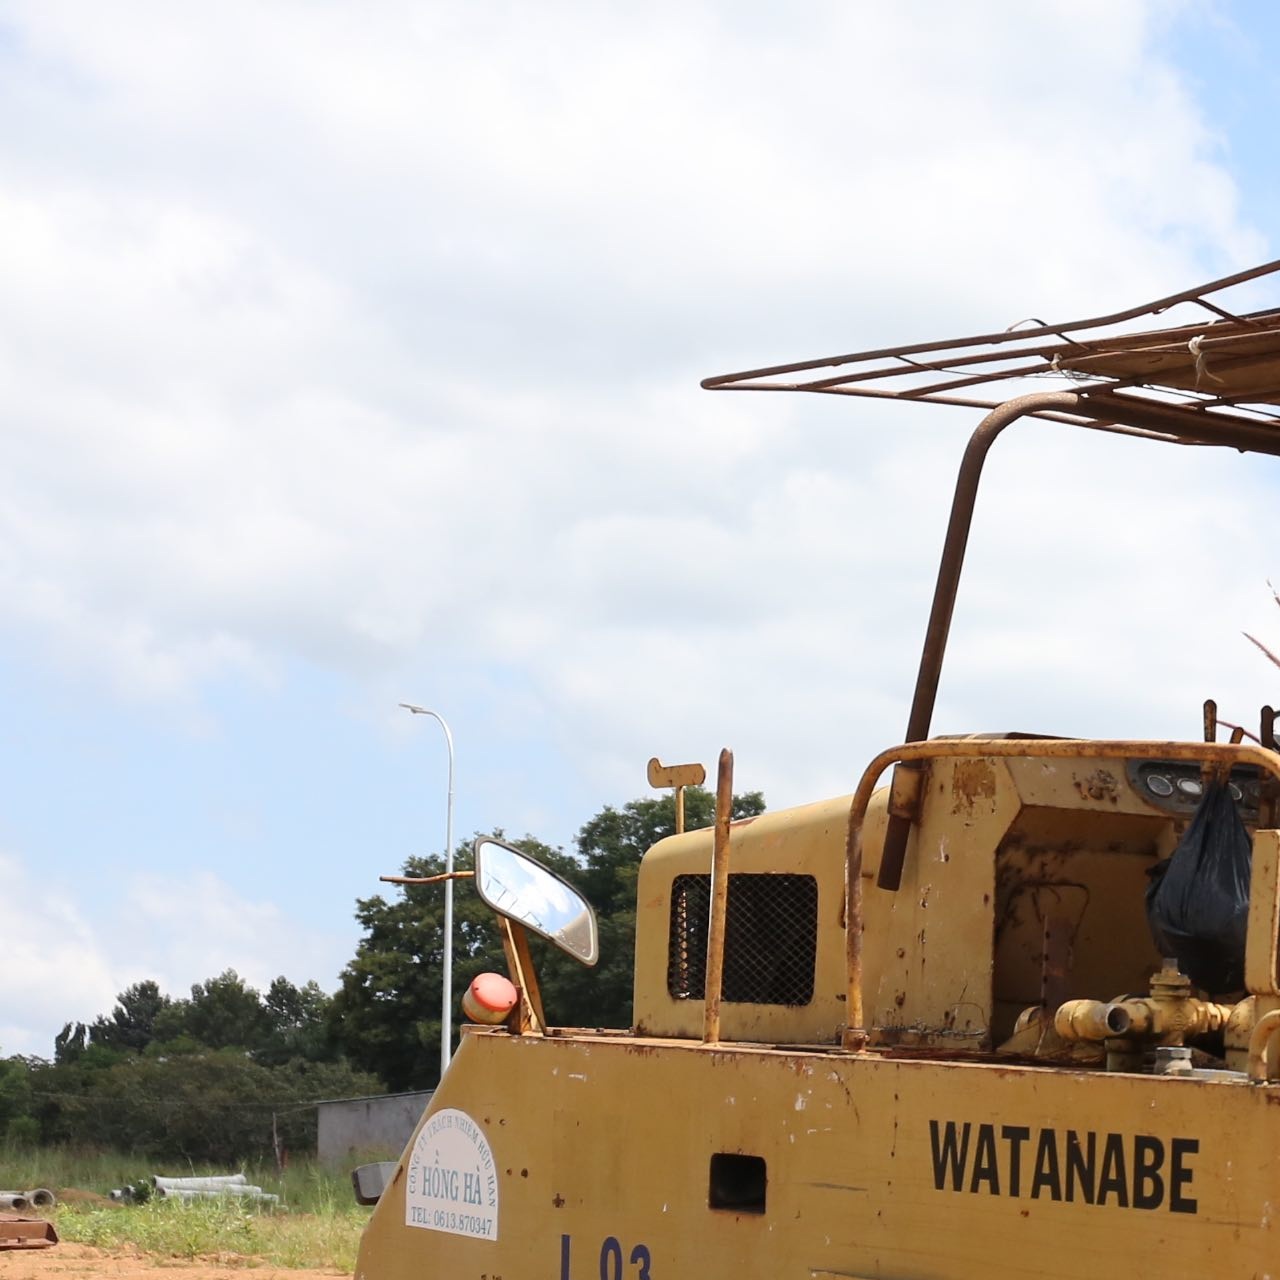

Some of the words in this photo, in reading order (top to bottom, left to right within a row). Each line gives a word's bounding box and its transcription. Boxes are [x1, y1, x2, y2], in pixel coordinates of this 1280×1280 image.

[422, 1148, 459, 1202] HỒNG
[463, 1164, 483, 1206] HÀ
[929, 1120, 1199, 1214] WATANABE
[411, 1206, 431, 1225] TEL:
[433, 1210, 493, 1236] 0613.870347
